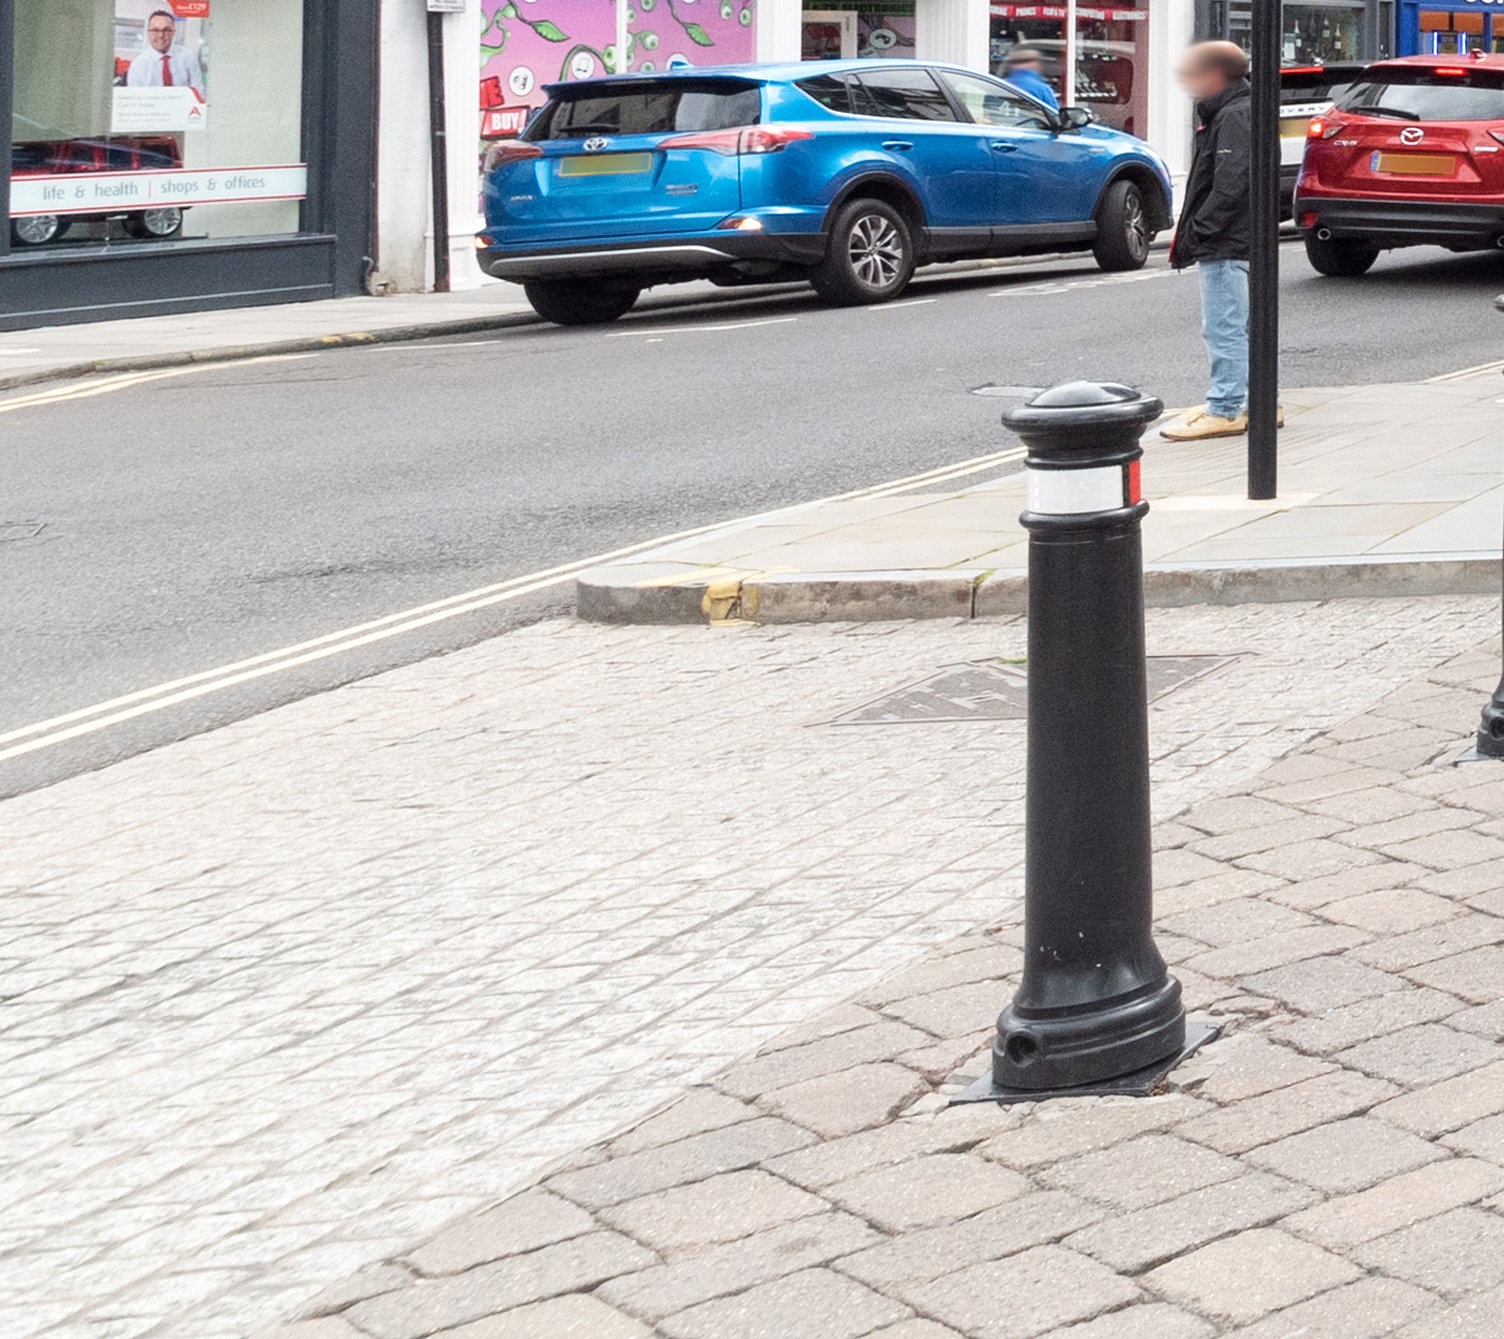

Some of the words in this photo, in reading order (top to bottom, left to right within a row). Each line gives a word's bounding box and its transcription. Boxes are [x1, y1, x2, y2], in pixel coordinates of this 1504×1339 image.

[43, 185, 65, 201] life
[74, 184, 85, 199] &
[94, 181, 138, 198] health
[160, 179, 199, 196] shops
[207, 179, 217, 191] &
[225, 175, 266, 190] offices
